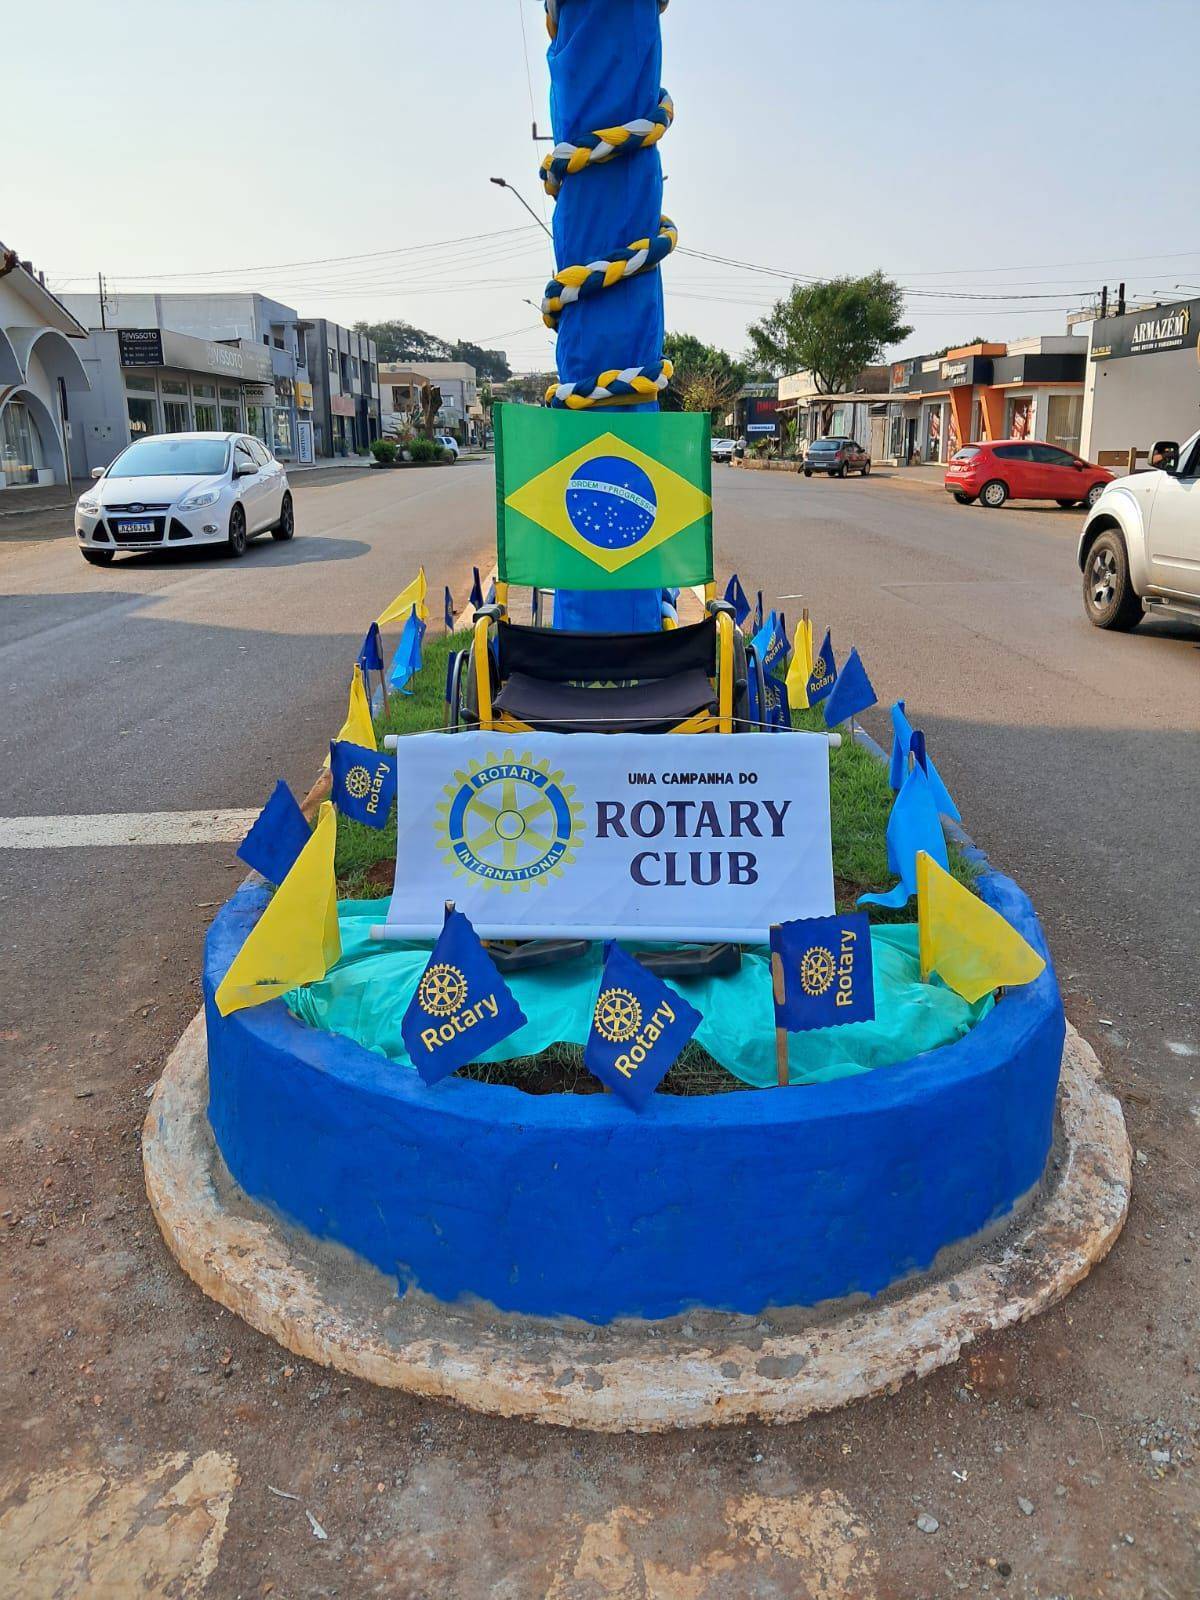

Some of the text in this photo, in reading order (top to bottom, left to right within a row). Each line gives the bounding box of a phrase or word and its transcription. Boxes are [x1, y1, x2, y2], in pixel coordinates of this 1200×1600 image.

[1132, 310, 1184, 343] ARMAZÉM
[571, 480, 599, 489] ORDEM
[608, 485, 654, 512] PROGRESSO
[810, 673, 835, 693] Rotary
[366, 762, 391, 814] Rotary
[478, 766, 541, 784] ROTARY
[628, 772, 758, 785] UMA CAMPANHA DO
[595, 800, 792, 838] ROTARY
[458, 848, 564, 880] INTERNATIONAL
[630, 851, 759, 886] CLUB
[836, 930, 857, 1007] Rotary
[420, 994, 499, 1053] Rotary
[614, 1000, 676, 1079] Rotary
